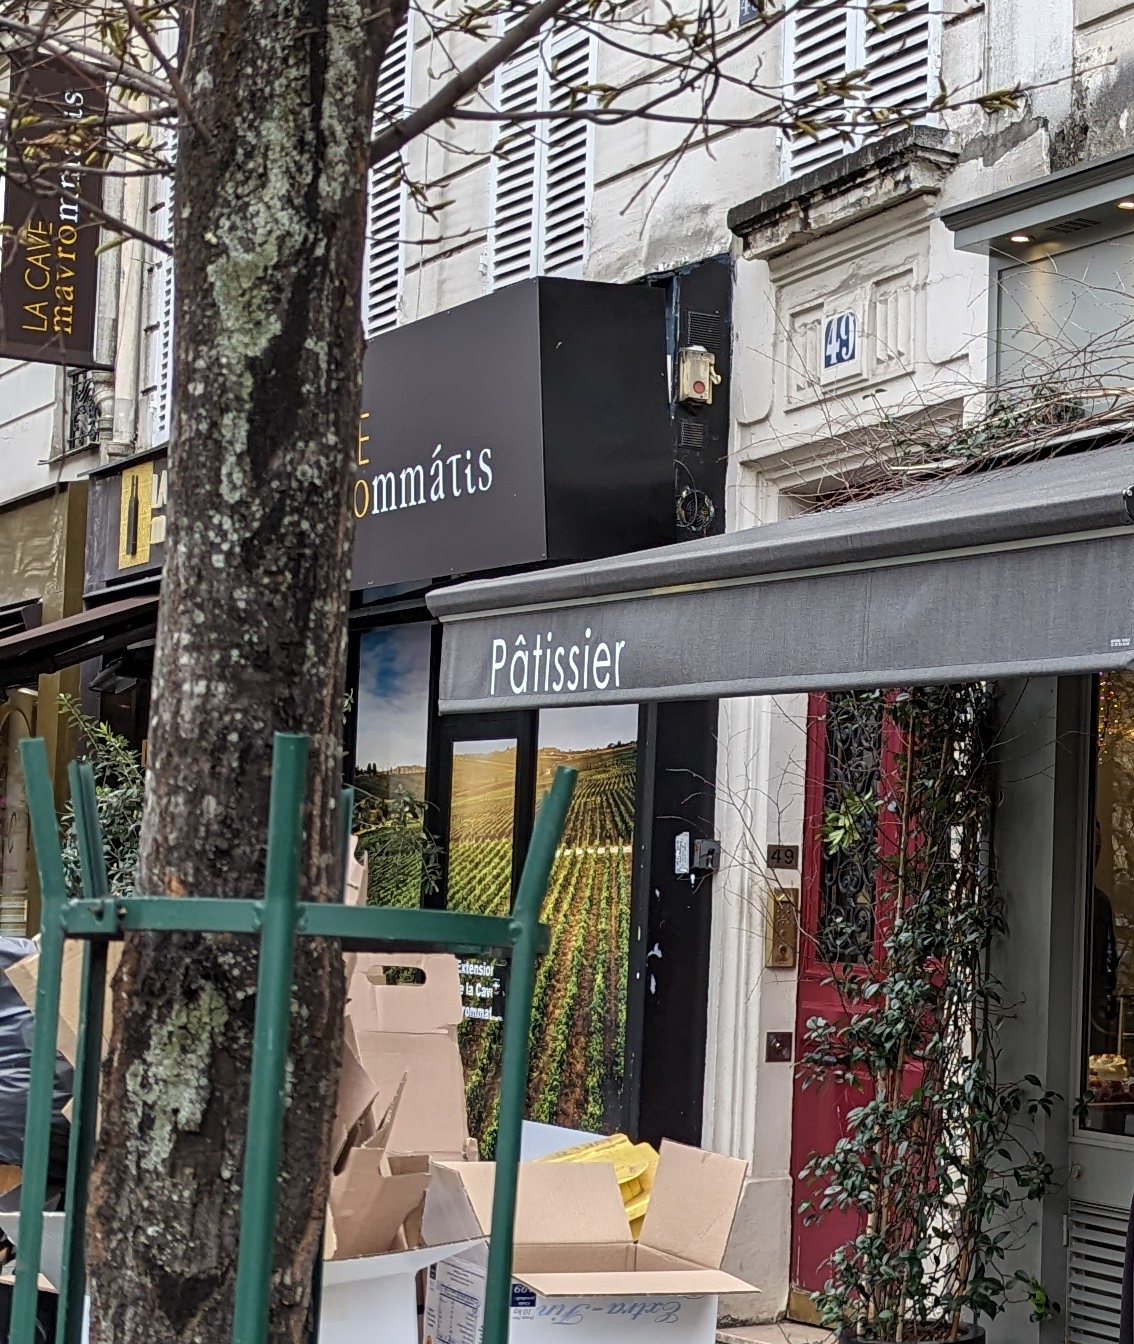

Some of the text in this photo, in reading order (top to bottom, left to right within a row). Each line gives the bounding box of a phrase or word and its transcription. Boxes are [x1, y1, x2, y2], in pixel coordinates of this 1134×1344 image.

[22, 220, 53, 333] LA CAVE
[826, 313, 855, 365] 49
[353, 444, 493, 518] ommátis
[490, 628, 626, 695] Pâtissier
[771, 848, 795, 864] 49
